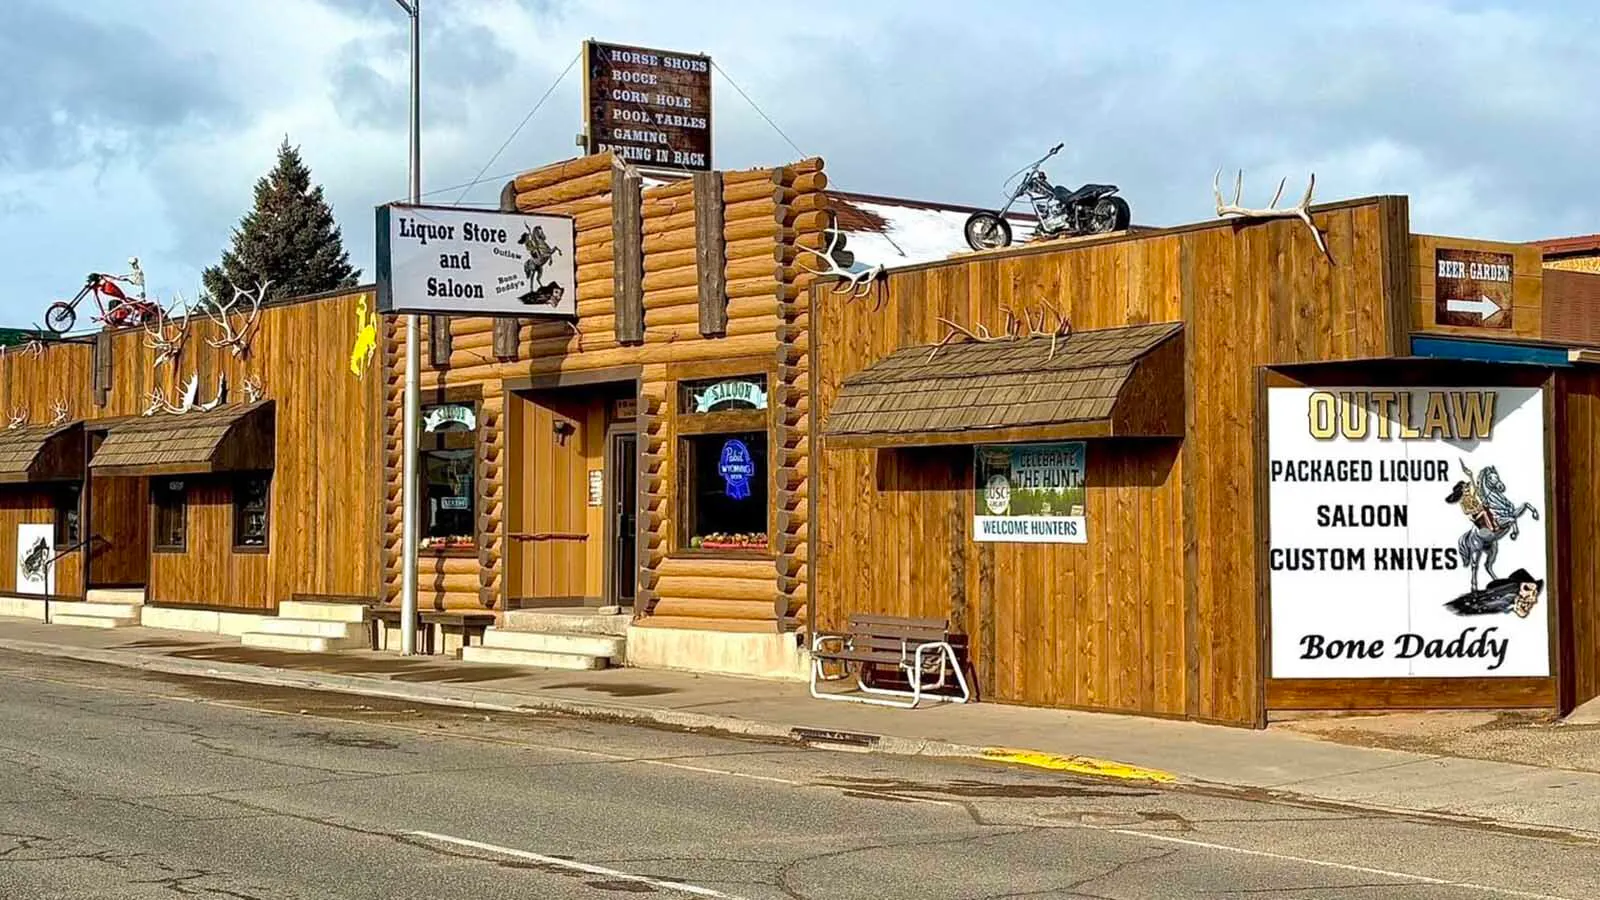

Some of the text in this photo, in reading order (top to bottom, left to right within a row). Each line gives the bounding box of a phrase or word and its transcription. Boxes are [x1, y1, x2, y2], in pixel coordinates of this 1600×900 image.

[611, 50, 707, 72] HORSE SHOES
[612, 70, 657, 85] BOCCE
[612, 89, 692, 108] CORN HOLE
[612, 108, 707, 129] POOL TABLES
[613, 128, 667, 144] GAMING
[656, 149, 668, 162] IN
[674, 151, 705, 166] BACK
[399, 218, 507, 244] Liquor Store
[440, 251, 471, 269] and
[493, 247, 522, 260] Outlaw
[1438, 260, 1510, 281] BEER GARDEN
[427, 277, 484, 299] Saloon
[712, 382, 751, 400] SALOON
[1308, 391, 1497, 441] OUTLAW
[1020, 452, 1077, 468] CELEBRATE
[1016, 469, 1079, 488] THE HUNT
[1271, 460, 1449, 482] PACKAGED LIQUOR
[1317, 504, 1408, 527] SALOON
[983, 521, 1077, 536] WELCOME HUNTERS
[1270, 548, 1458, 571] CUSTOM KNIVES
[1299, 627, 1509, 670] Bone Daddy
